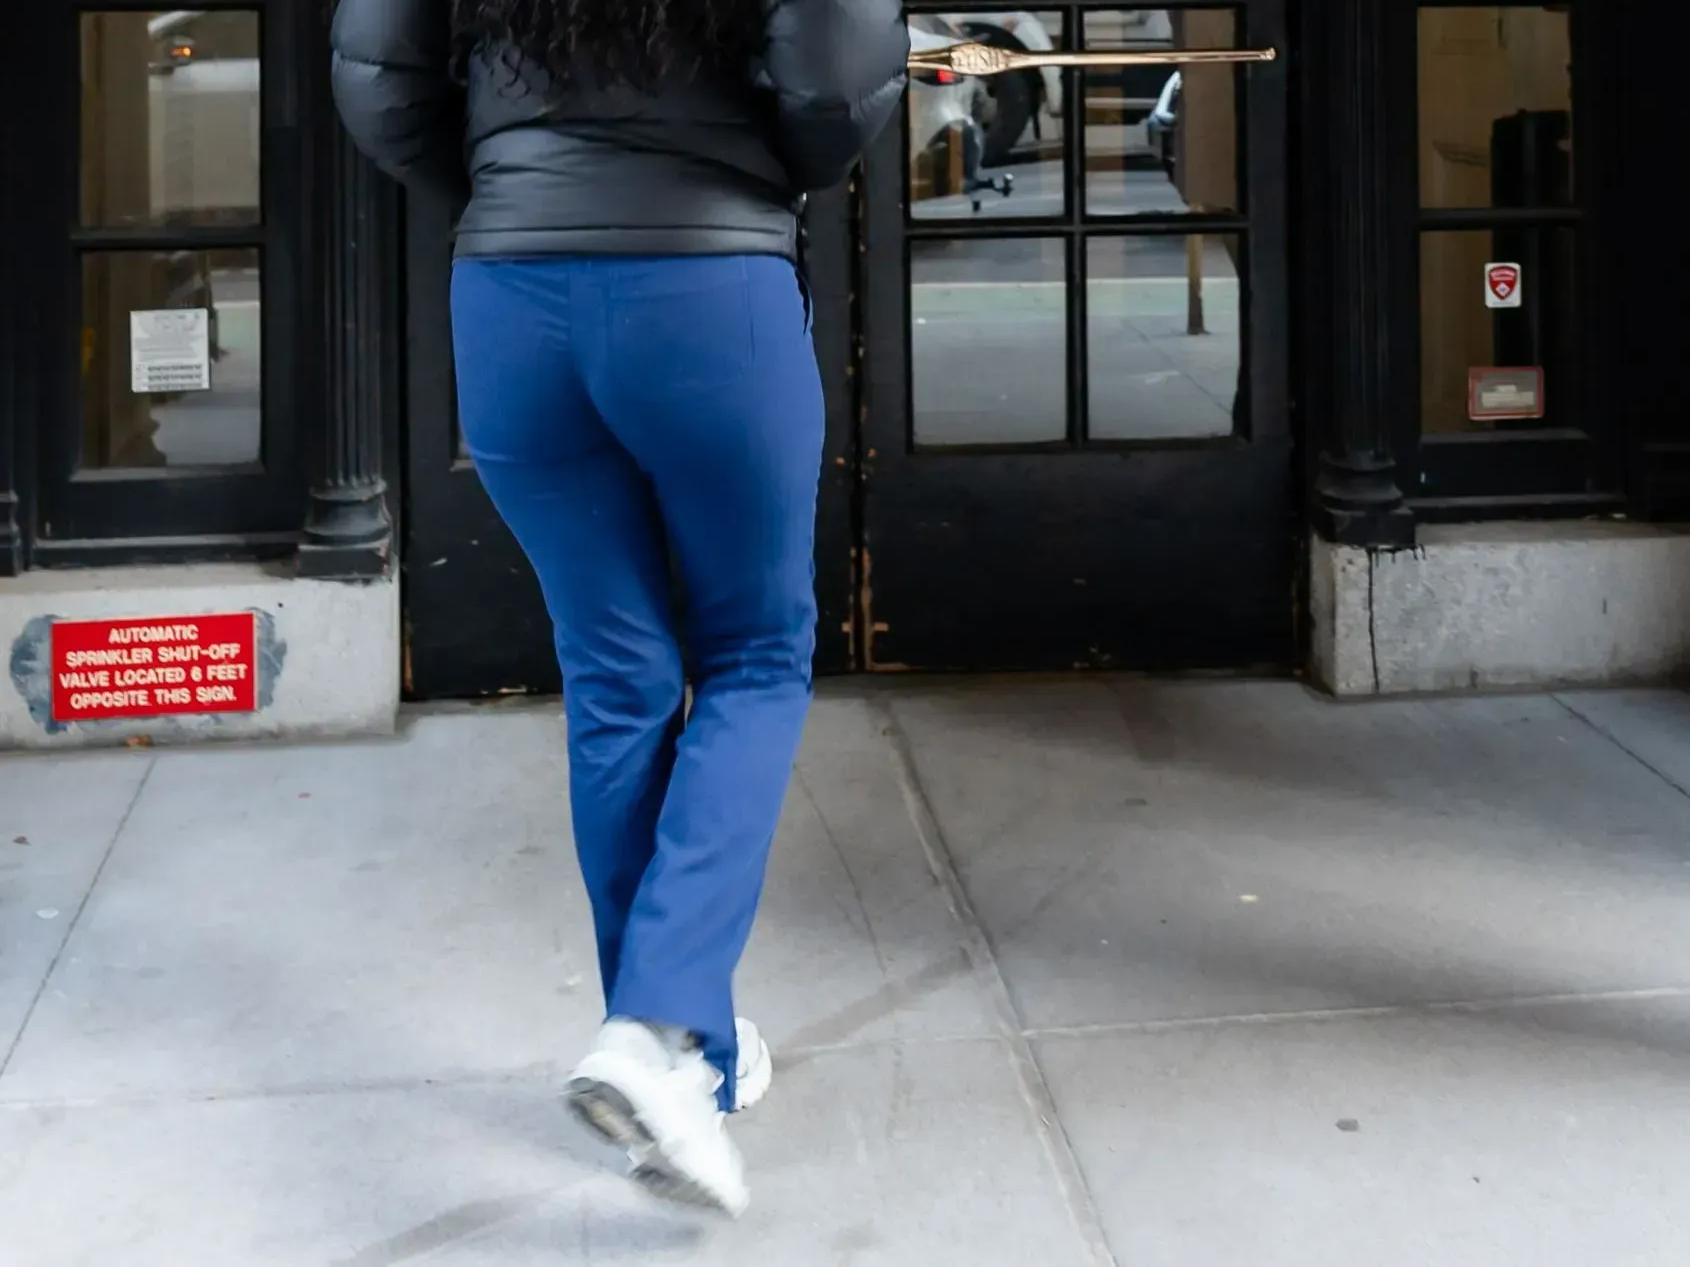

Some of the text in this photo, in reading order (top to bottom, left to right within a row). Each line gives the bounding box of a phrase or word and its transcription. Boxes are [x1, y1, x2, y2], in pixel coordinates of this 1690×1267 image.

[108, 624, 199, 644] AUTOMATIC
[66, 643, 241, 668] SPRINKLER SHUT-OFF
[59, 671, 110, 689] VALVE
[114, 667, 186, 687] LOCATED
[206, 663, 248, 681] FEET
[70, 685, 237, 710] OPPOSITE THIS SIGN.
